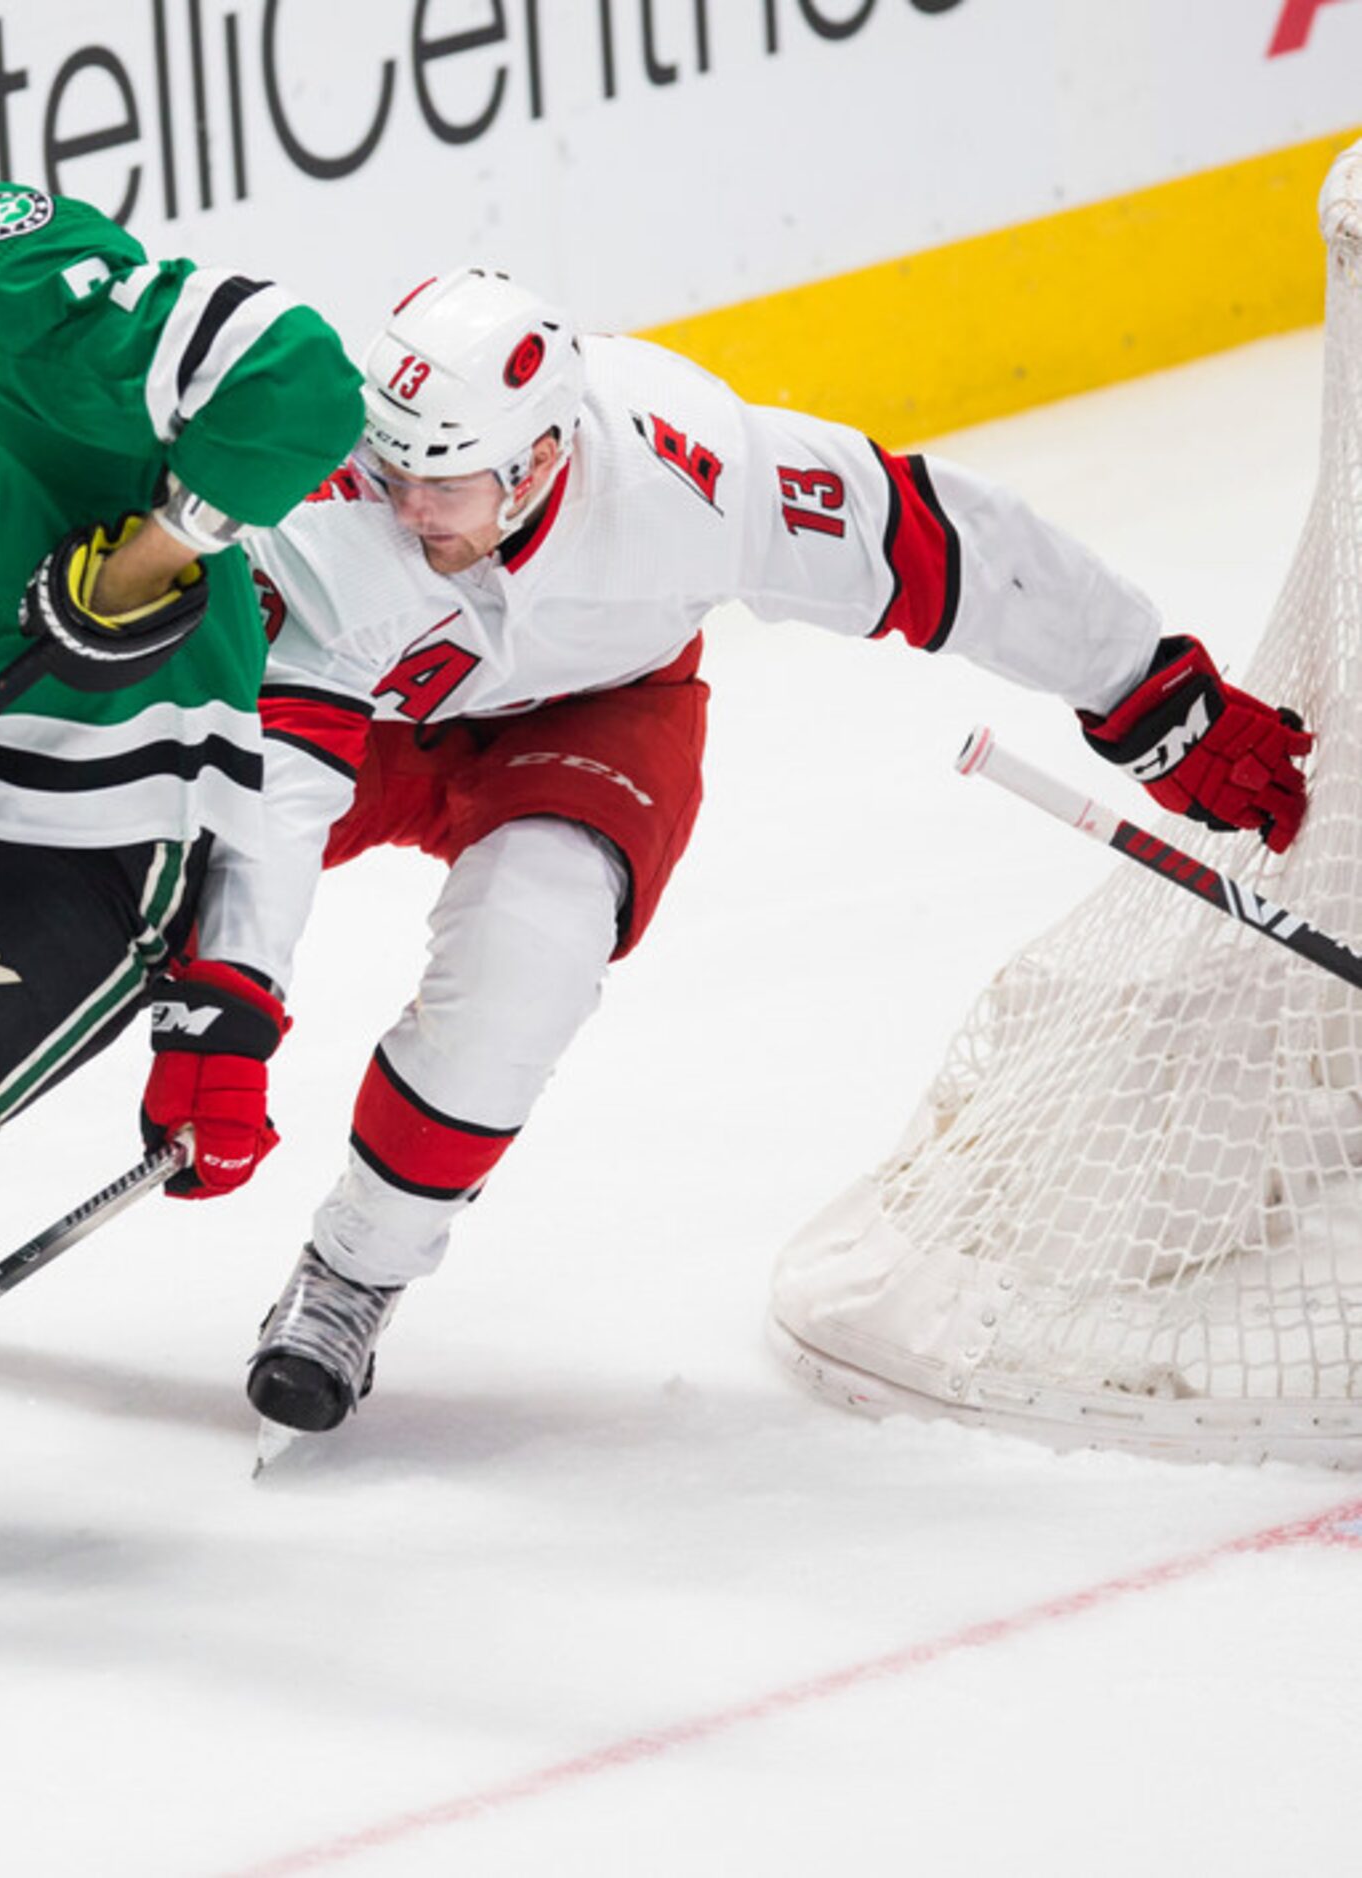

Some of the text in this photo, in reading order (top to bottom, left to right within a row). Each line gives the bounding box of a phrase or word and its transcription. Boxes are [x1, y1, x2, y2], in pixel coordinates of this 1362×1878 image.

[388, 355, 431, 400] 13
[777, 465, 845, 539] 13
[370, 637, 483, 723] A
[506, 752, 655, 806] CCM
